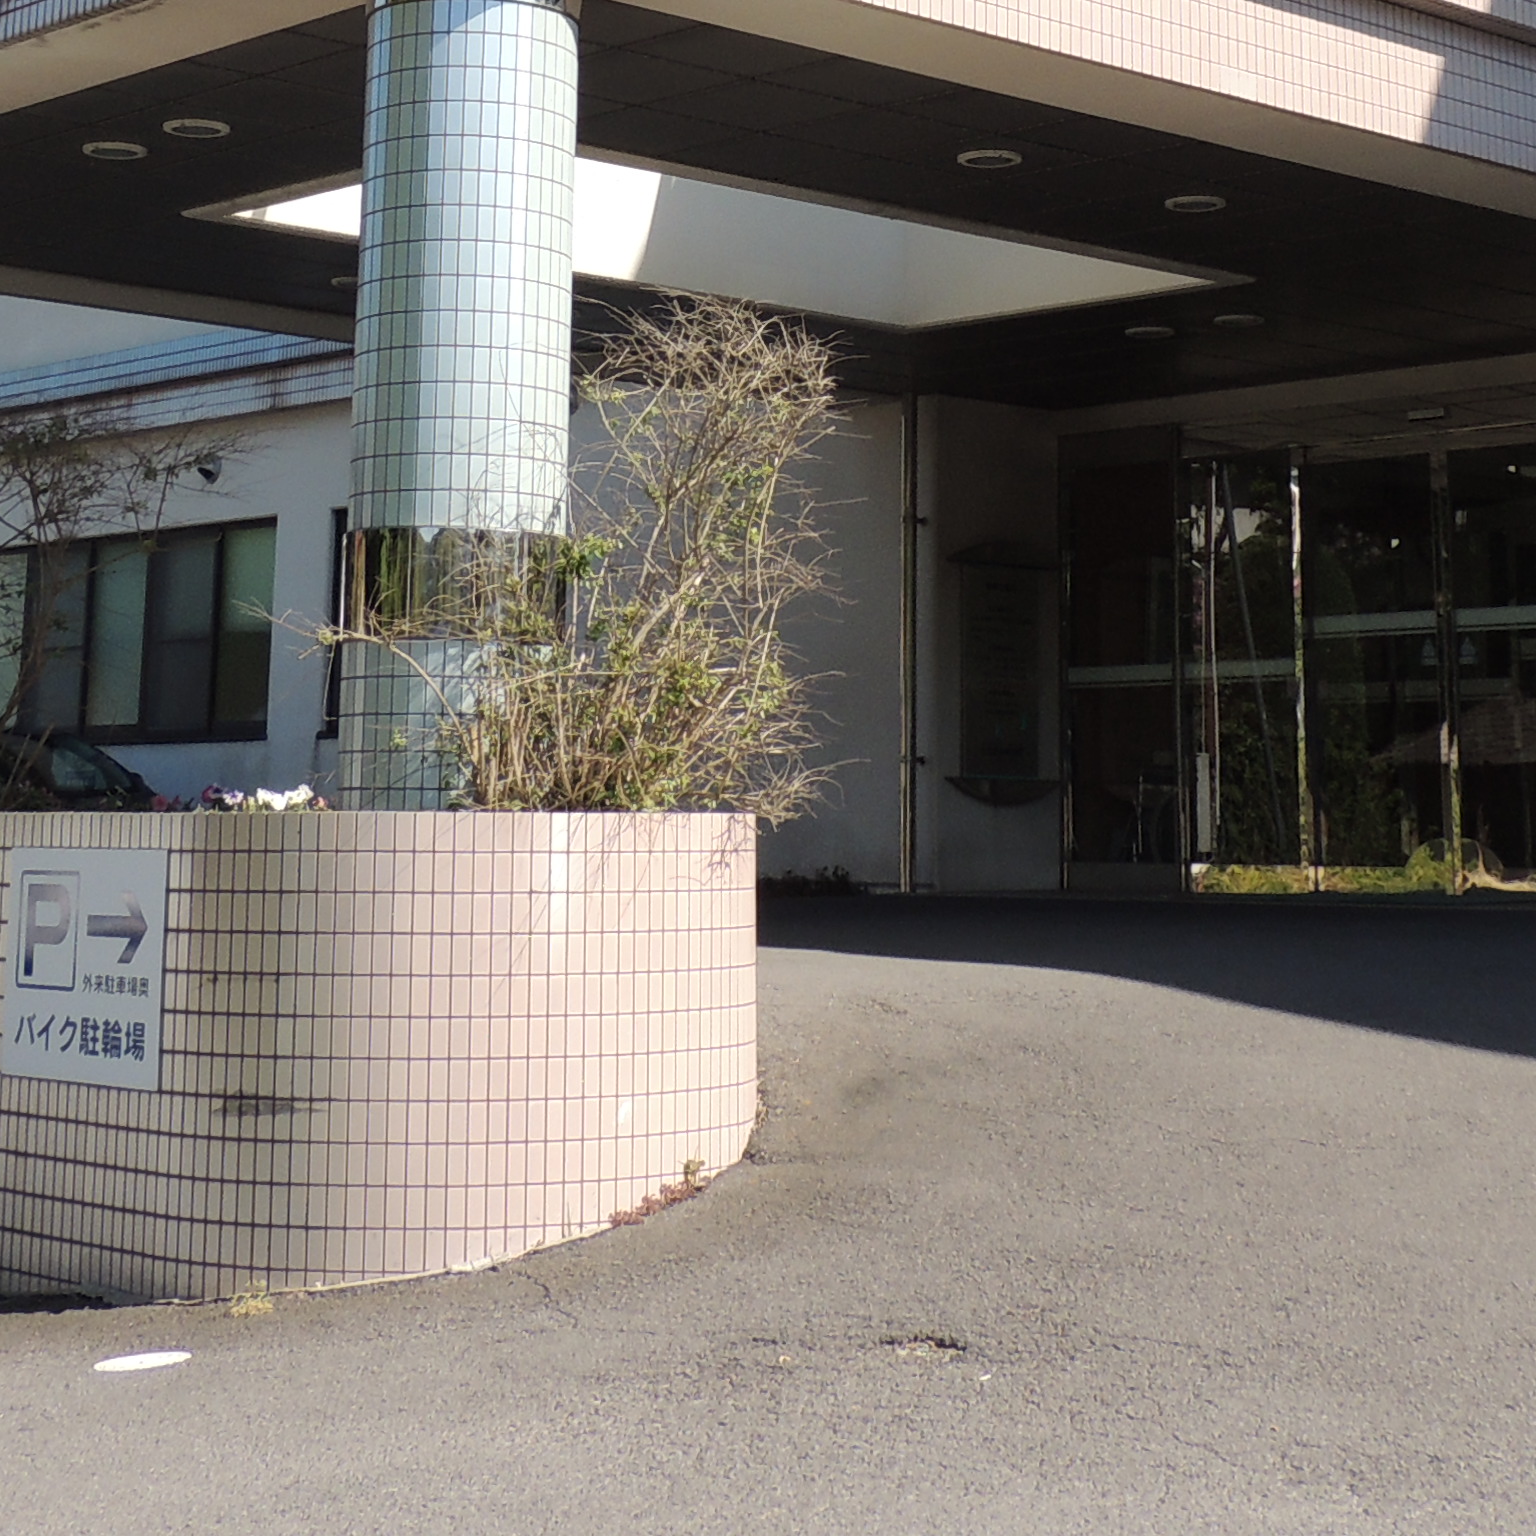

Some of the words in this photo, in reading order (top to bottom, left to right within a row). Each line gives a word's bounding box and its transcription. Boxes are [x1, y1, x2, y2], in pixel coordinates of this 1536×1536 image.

[24, 883, 70, 976] P
[82, 973, 149, 998] 外来駐車場奥
[15, 1013, 145, 1062] バイク駐輪場
